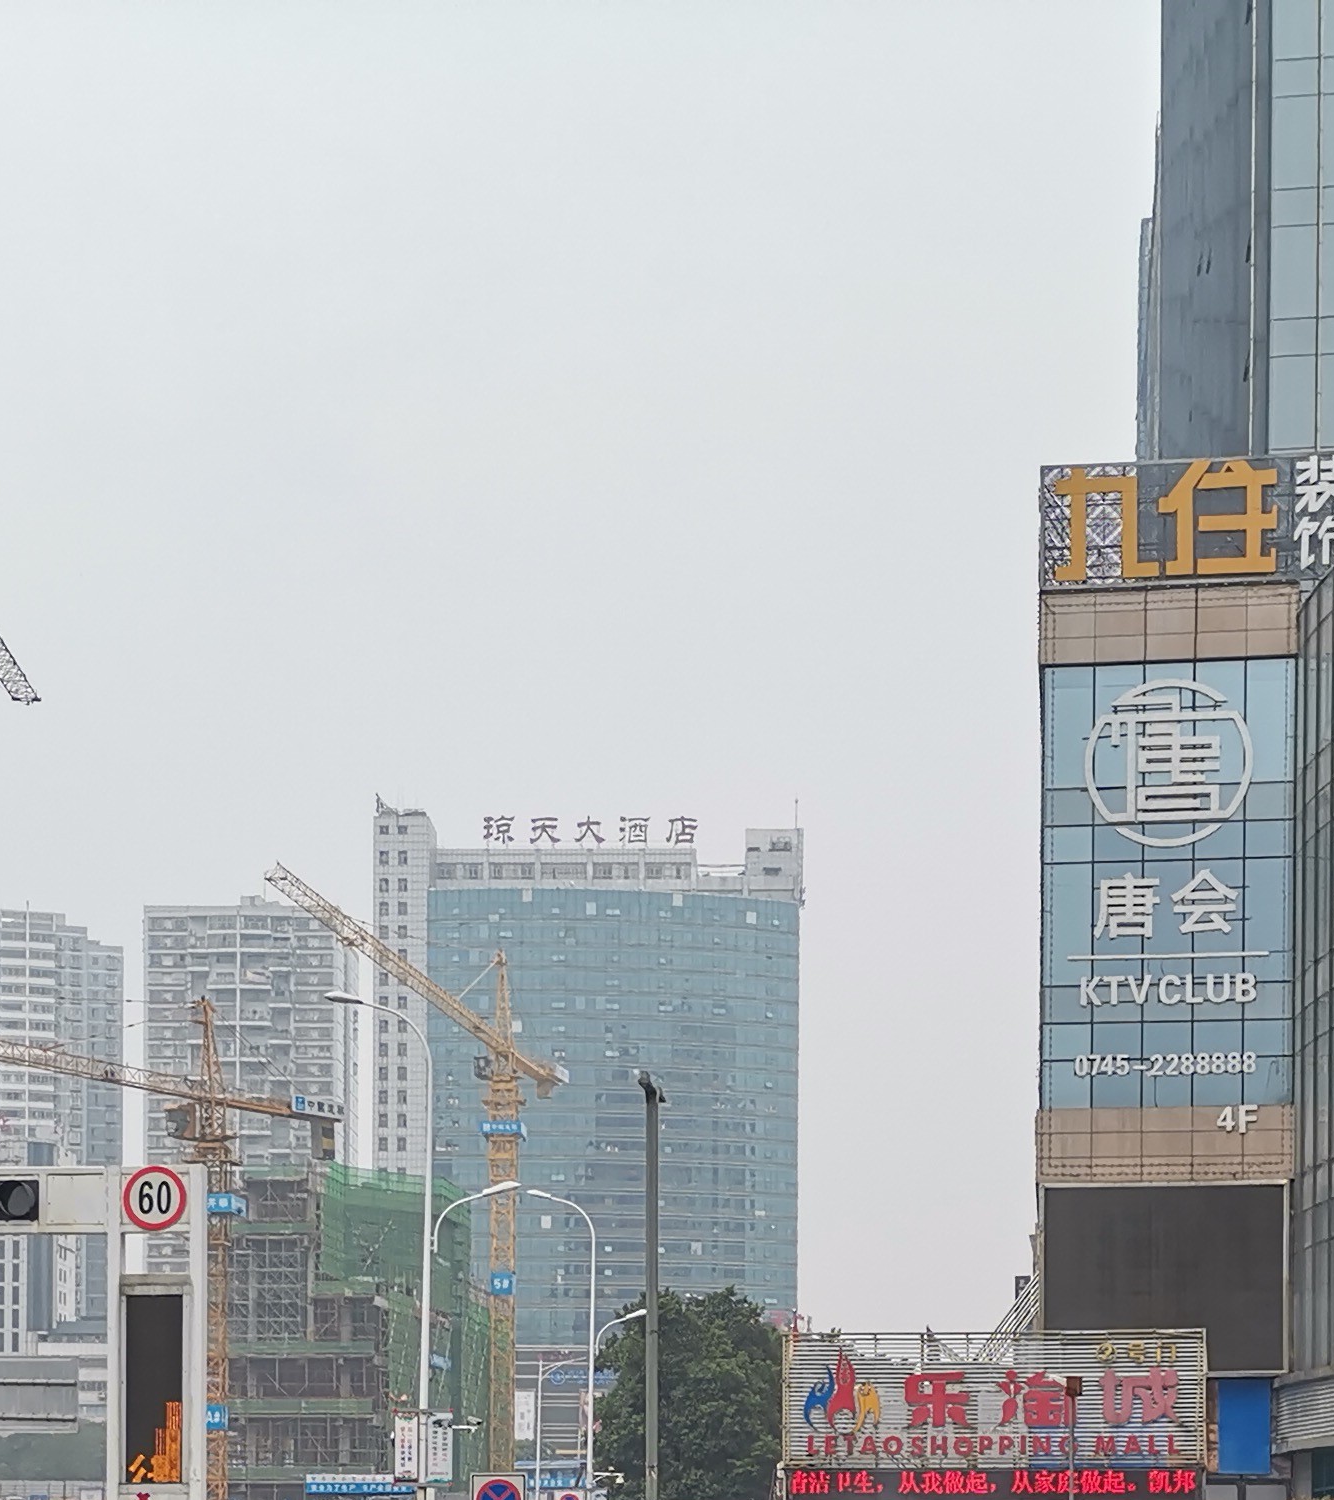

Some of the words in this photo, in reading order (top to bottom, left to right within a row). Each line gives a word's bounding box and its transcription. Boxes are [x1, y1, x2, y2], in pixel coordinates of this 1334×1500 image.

[1094, 868, 1240, 940] 唐会
[1074, 1051, 1257, 1078] 0745-2288888
[1216, 1104, 1259, 1135] 4F
[138, 1180, 172, 1215] 60
[904, 1366, 1183, 1430] 乐淘城
[1093, 1433, 1181, 1456] MALL
